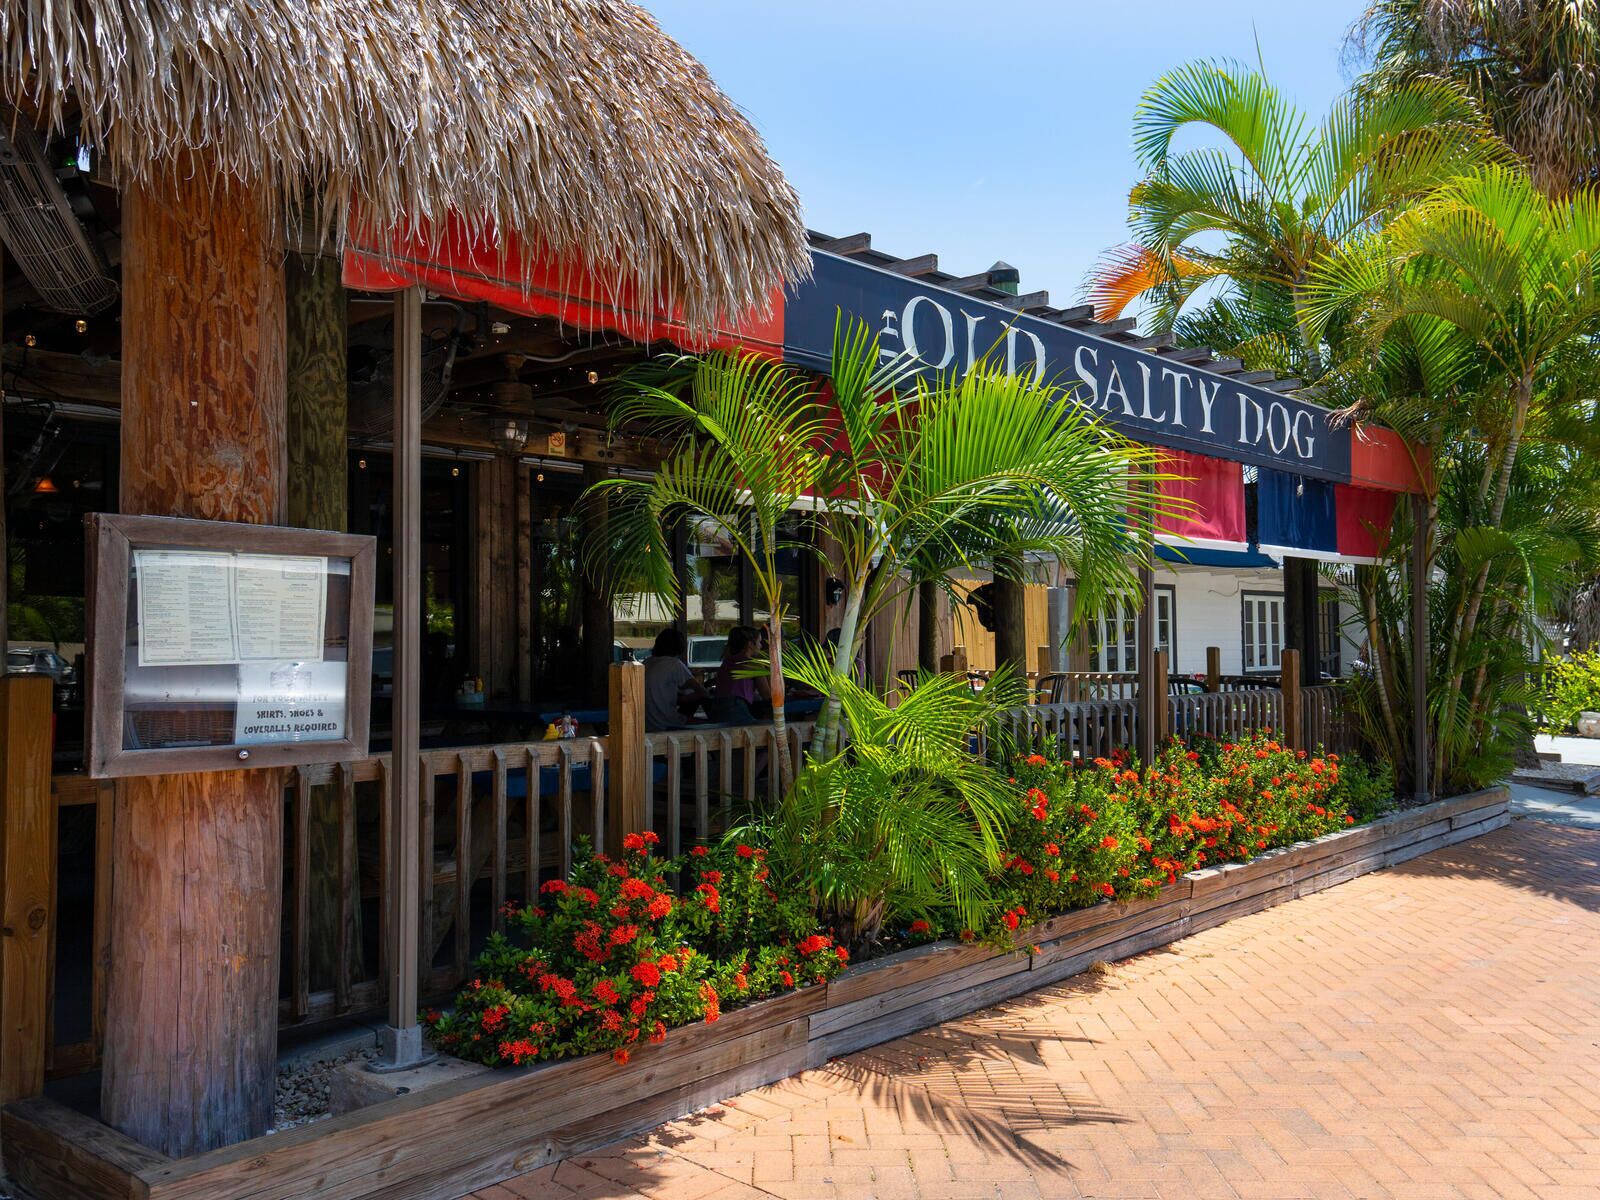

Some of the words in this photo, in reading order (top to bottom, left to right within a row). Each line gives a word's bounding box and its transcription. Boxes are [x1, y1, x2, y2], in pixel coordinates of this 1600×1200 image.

[901, 295, 1047, 393] OLD
[1073, 345, 1222, 435] SALTY
[1236, 391, 1316, 459] DOG
[289, 708, 315, 718] SHOES
[317, 708, 324, 717] &
[244, 723, 292, 735] COVERALLS
[293, 721, 338, 733] REQUIRED
